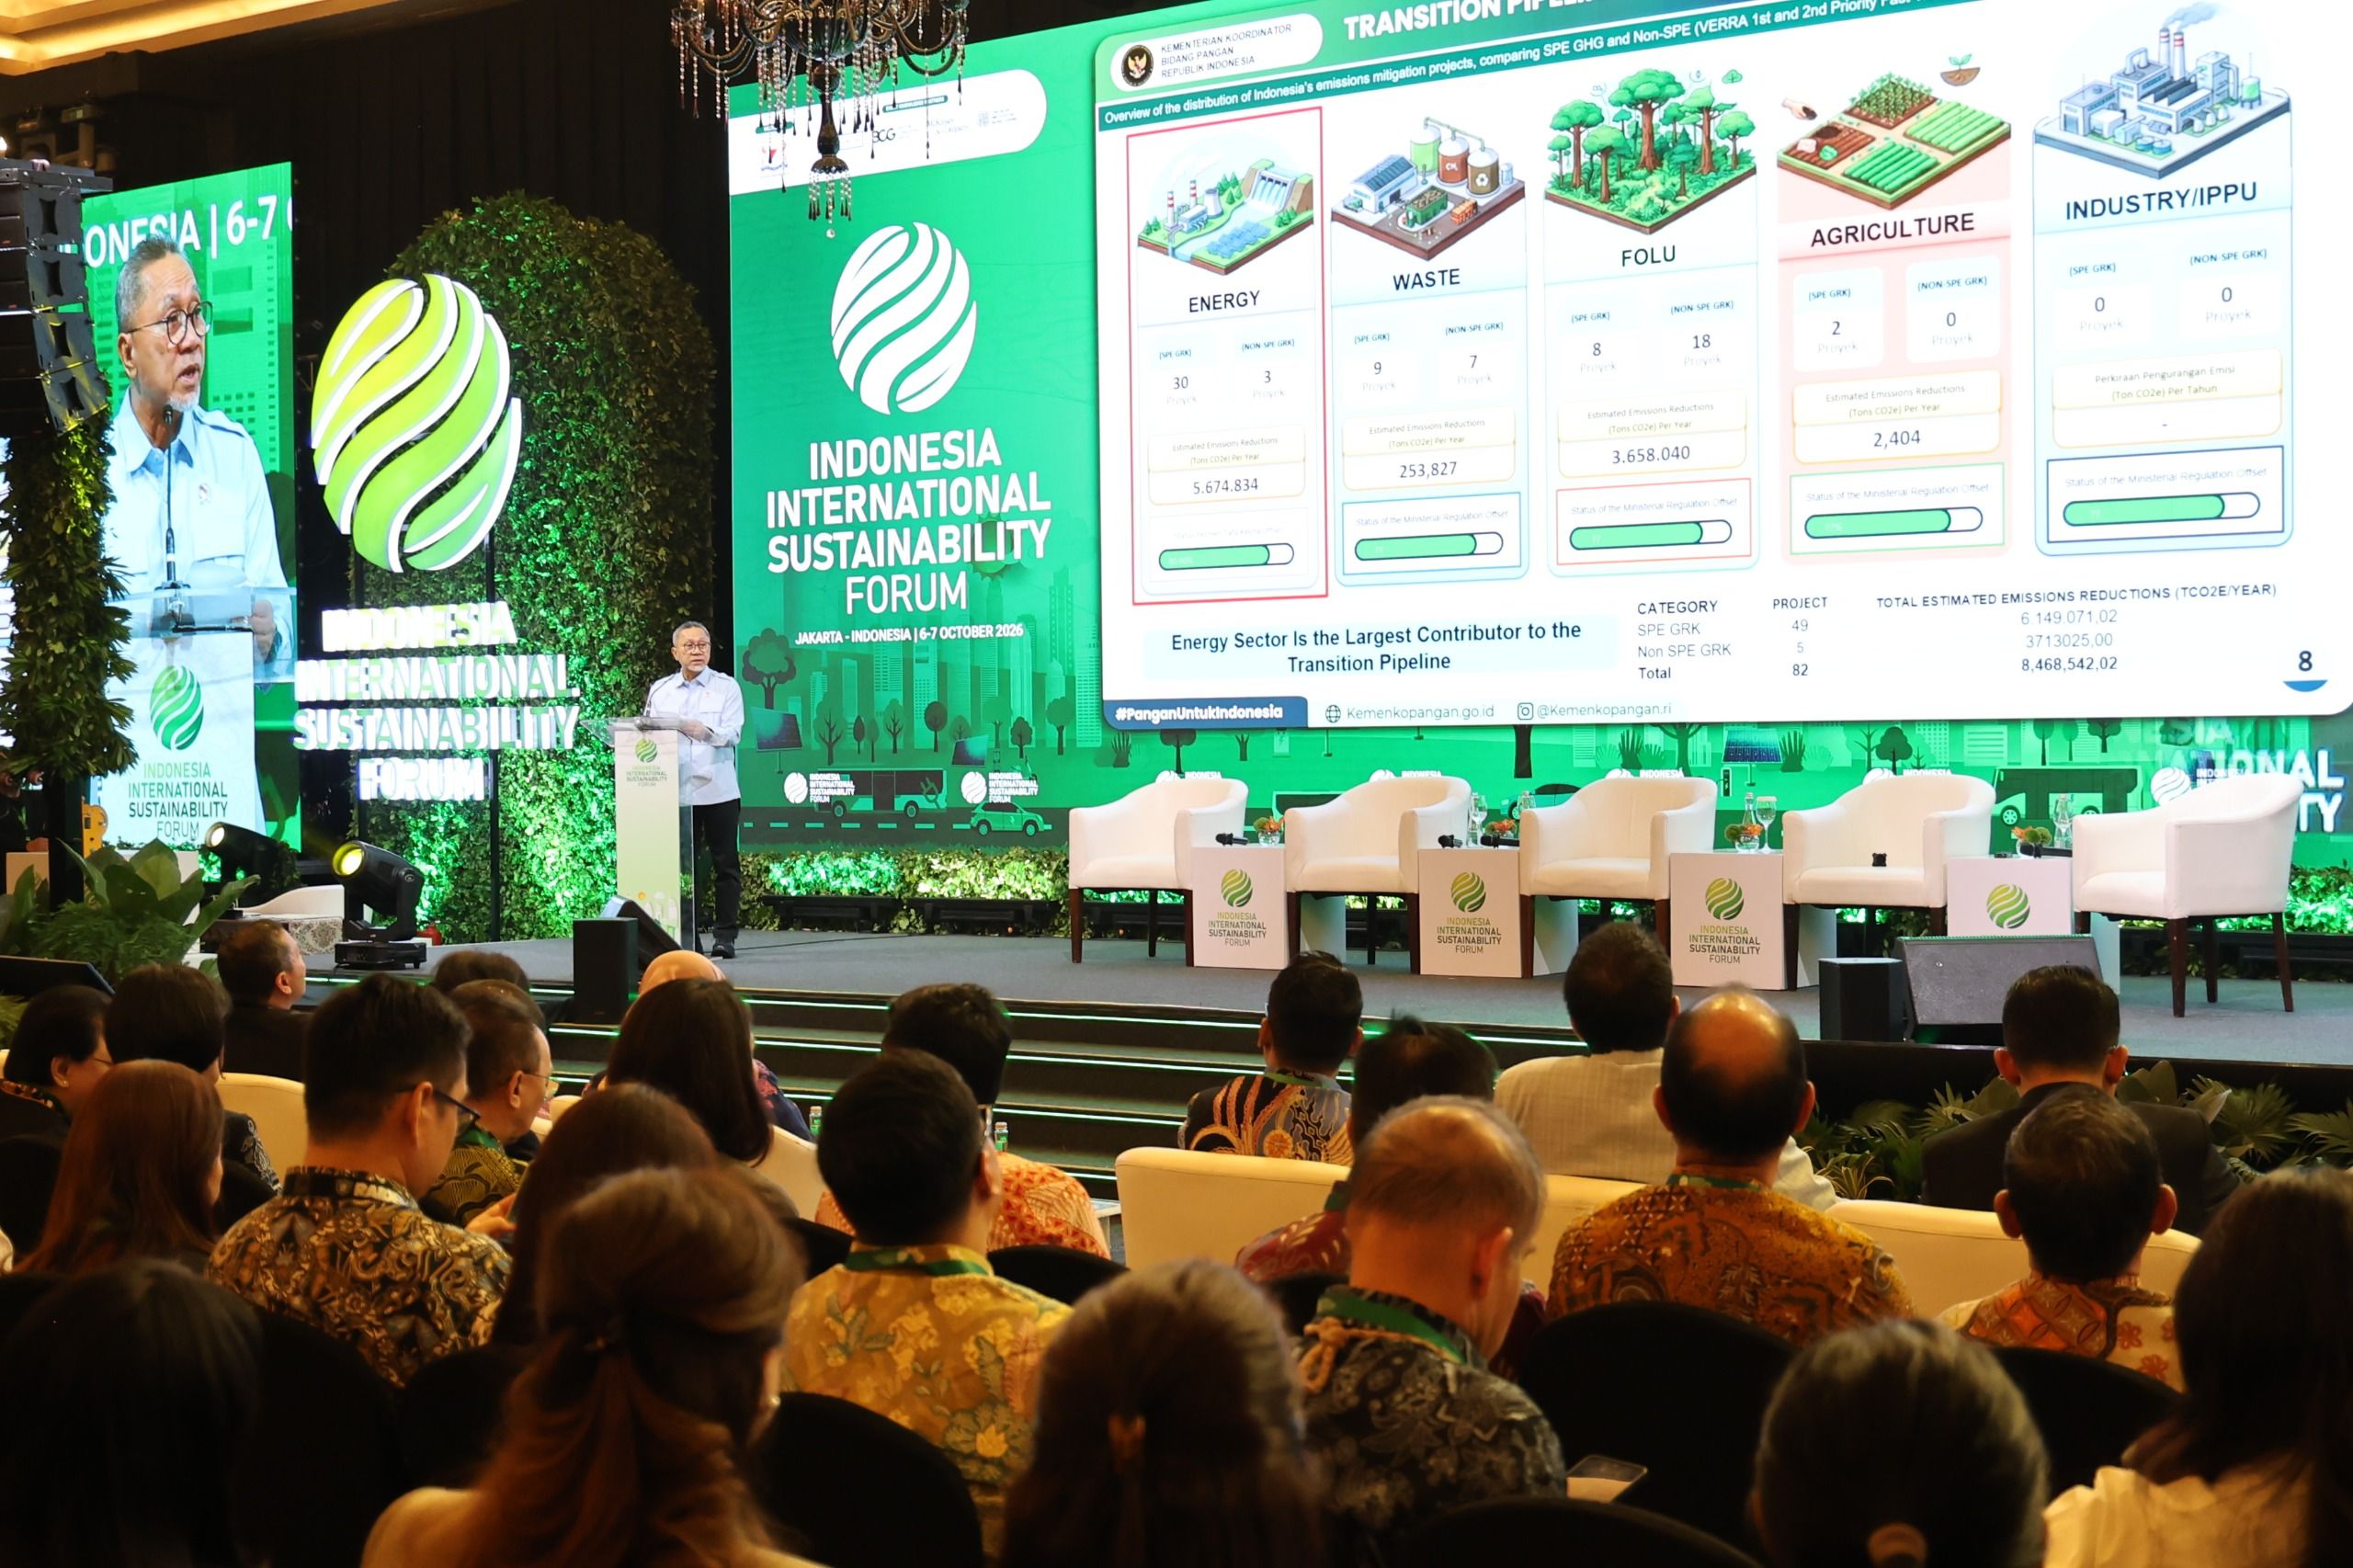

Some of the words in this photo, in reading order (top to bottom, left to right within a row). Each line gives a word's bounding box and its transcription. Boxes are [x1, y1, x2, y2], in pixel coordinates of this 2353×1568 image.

[1344, 0, 1500, 40] TRANSITION
[1161, 36, 1223, 53] KEMENTERIAN
[1225, 24, 1292, 43] KOORDINATOR
[1105, 107, 1151, 124] Overview
[1153, 104, 1164, 117] of
[1165, 101, 1181, 114] the
[1183, 94, 1239, 112] distribution
[1241, 90, 1253, 103] of
[1254, 81, 1314, 101] Indonesia's
[1316, 73, 1370, 92] emissions
[1372, 64, 1427, 85] mitigation
[1428, 55, 1477, 77] projects,
[1479, 47, 1540, 69] comparing
[1543, 40, 1571, 57] SPE
[1573, 35, 1604, 53] GHG
[1607, 30, 1630, 47] and
[1633, 22, 1691, 45] Non-SPE
[1694, 15, 1748, 38] (VERRA
[1752, 11, 1772, 27] 1st
[1774, 6, 1800, 23] and
[1802, 2, 1827, 18] 2nd
[1161, 52, 1195, 65] BIDANG
[1197, 46, 1234, 61] PANGAN
[1161, 64, 1205, 79] REPUBLIK
[1207, 55, 1256, 72] INDONESIA
[2065, 181, 2257, 221] INDUSTRY/IPPU
[226, 194, 278, 245] 6-7
[1810, 212, 1975, 247] AGRICULTURE
[1620, 244, 1677, 267] FOLU
[1392, 267, 1461, 291] WASTE
[1188, 290, 1260, 313] ENERGY
[1831, 321, 1841, 335] 2
[1592, 342, 1602, 357] 8
[1692, 334, 1711, 349] 18
[1373, 361, 1382, 375] 9
[1470, 355, 1478, 369] 7
[1173, 376, 1189, 390] 30
[1264, 370, 1272, 383] 3
[2095, 371, 2141, 384] Perkiraan
[2143, 367, 2207, 381] Pengurangan
[2210, 365, 2235, 376] Emisi
[2168, 386, 2186, 396] Per
[2188, 384, 2218, 394] Tahun
[1587, 409, 1627, 420] Estimated
[1629, 406, 1667, 416] Emissions
[1669, 403, 1714, 414] Reductions
[1658, 422, 1672, 430] Per
[1674, 420, 1692, 429] Year
[1873, 429, 1921, 450] 2,404
[810, 426, 1002, 481] INDONESIA
[1611, 445, 1691, 465] 3.658.040
[1399, 461, 1458, 480] 253,827
[1192, 477, 1259, 495] 5.674.834
[767, 471, 1051, 529] INTERNATIONAL
[767, 517, 1052, 574] SUSTAINABILITY
[846, 571, 967, 615] FORUM
[1637, 600, 1719, 615] CATEGORY
[1773, 597, 1828, 610] PROJECT
[1877, 597, 1918, 608] TOTAL
[1922, 593, 1997, 607] ESTIMATED
[2001, 591, 2075, 605] EMISSIONS
[2080, 587, 2171, 602] REDUCTIONS
[2175, 583, 2278, 601] (TCO2E/YEAR)
[322, 600, 518, 652] INDONESIA
[795, 629, 844, 645] JAKARTA
[851, 627, 912, 644] INDONESIA
[918, 625, 938, 641] 6-7
[939, 624, 995, 641] OCTOBER
[995, 622, 1024, 639] 2026
[1637, 623, 1665, 637] SPE
[1670, 621, 1701, 636] GRK
[1791, 619, 1809, 632] 49
[1171, 633, 1229, 653] Energy
[1233, 631, 1288, 649] Sector
[1293, 630, 1308, 646] Is
[1313, 629, 1340, 646] the
[1346, 626, 1412, 648] Largest
[1417, 623, 1522, 642] Contributor
[1528, 623, 1546, 640] to
[1552, 621, 1582, 640] the
[1637, 644, 1664, 658] Non
[1667, 643, 1696, 658] SPE
[1700, 642, 1732, 657] GRK
[1796, 642, 1804, 653] 5
[1287, 653, 1374, 673] Transition
[1380, 652, 1451, 674] Pipeline
[1638, 666, 1672, 680] Total
[1791, 664, 1809, 676] 82
[2021, 656, 2119, 673] 8,468,542,02
[2298, 650, 2313, 672] 8
[294, 653, 581, 702] INTERNATIONAL
[1115, 702, 1284, 724] #PanganUntukIndonesia
[1347, 704, 1495, 722] Kemenkopangan.go.id
[1537, 701, 1673, 719] @Kemenkopangan.ri
[292, 705, 580, 751] SUSTAINABILITY
[143, 761, 211, 779] INDONESIA
[358, 756, 485, 801] FORUM
[128, 781, 228, 799] INTERNATIONAL
[129, 801, 228, 818] SUSTAINABILITY
[156, 821, 199, 838] FORUM
[1208, 920, 1267, 930] INTERNATIONAL
[1217, 911, 1257, 920] INDONESIA
[1447, 916, 1491, 926] INDONESIA
[1208, 928, 1267, 938] SUSTAINABILITY
[1437, 926, 1502, 937] INTERNATIONAL
[1437, 935, 1503, 945] SUSTAINABILITY
[1688, 934, 1761, 946] INTERNATIONAL
[1699, 925, 1749, 936] INDONESIA
[1224, 937, 1251, 947] FORUM
[1455, 945, 1483, 954] FORUM
[1689, 943, 1761, 956] SUSTAINABILITY
[1709, 954, 1741, 964] FORUM
